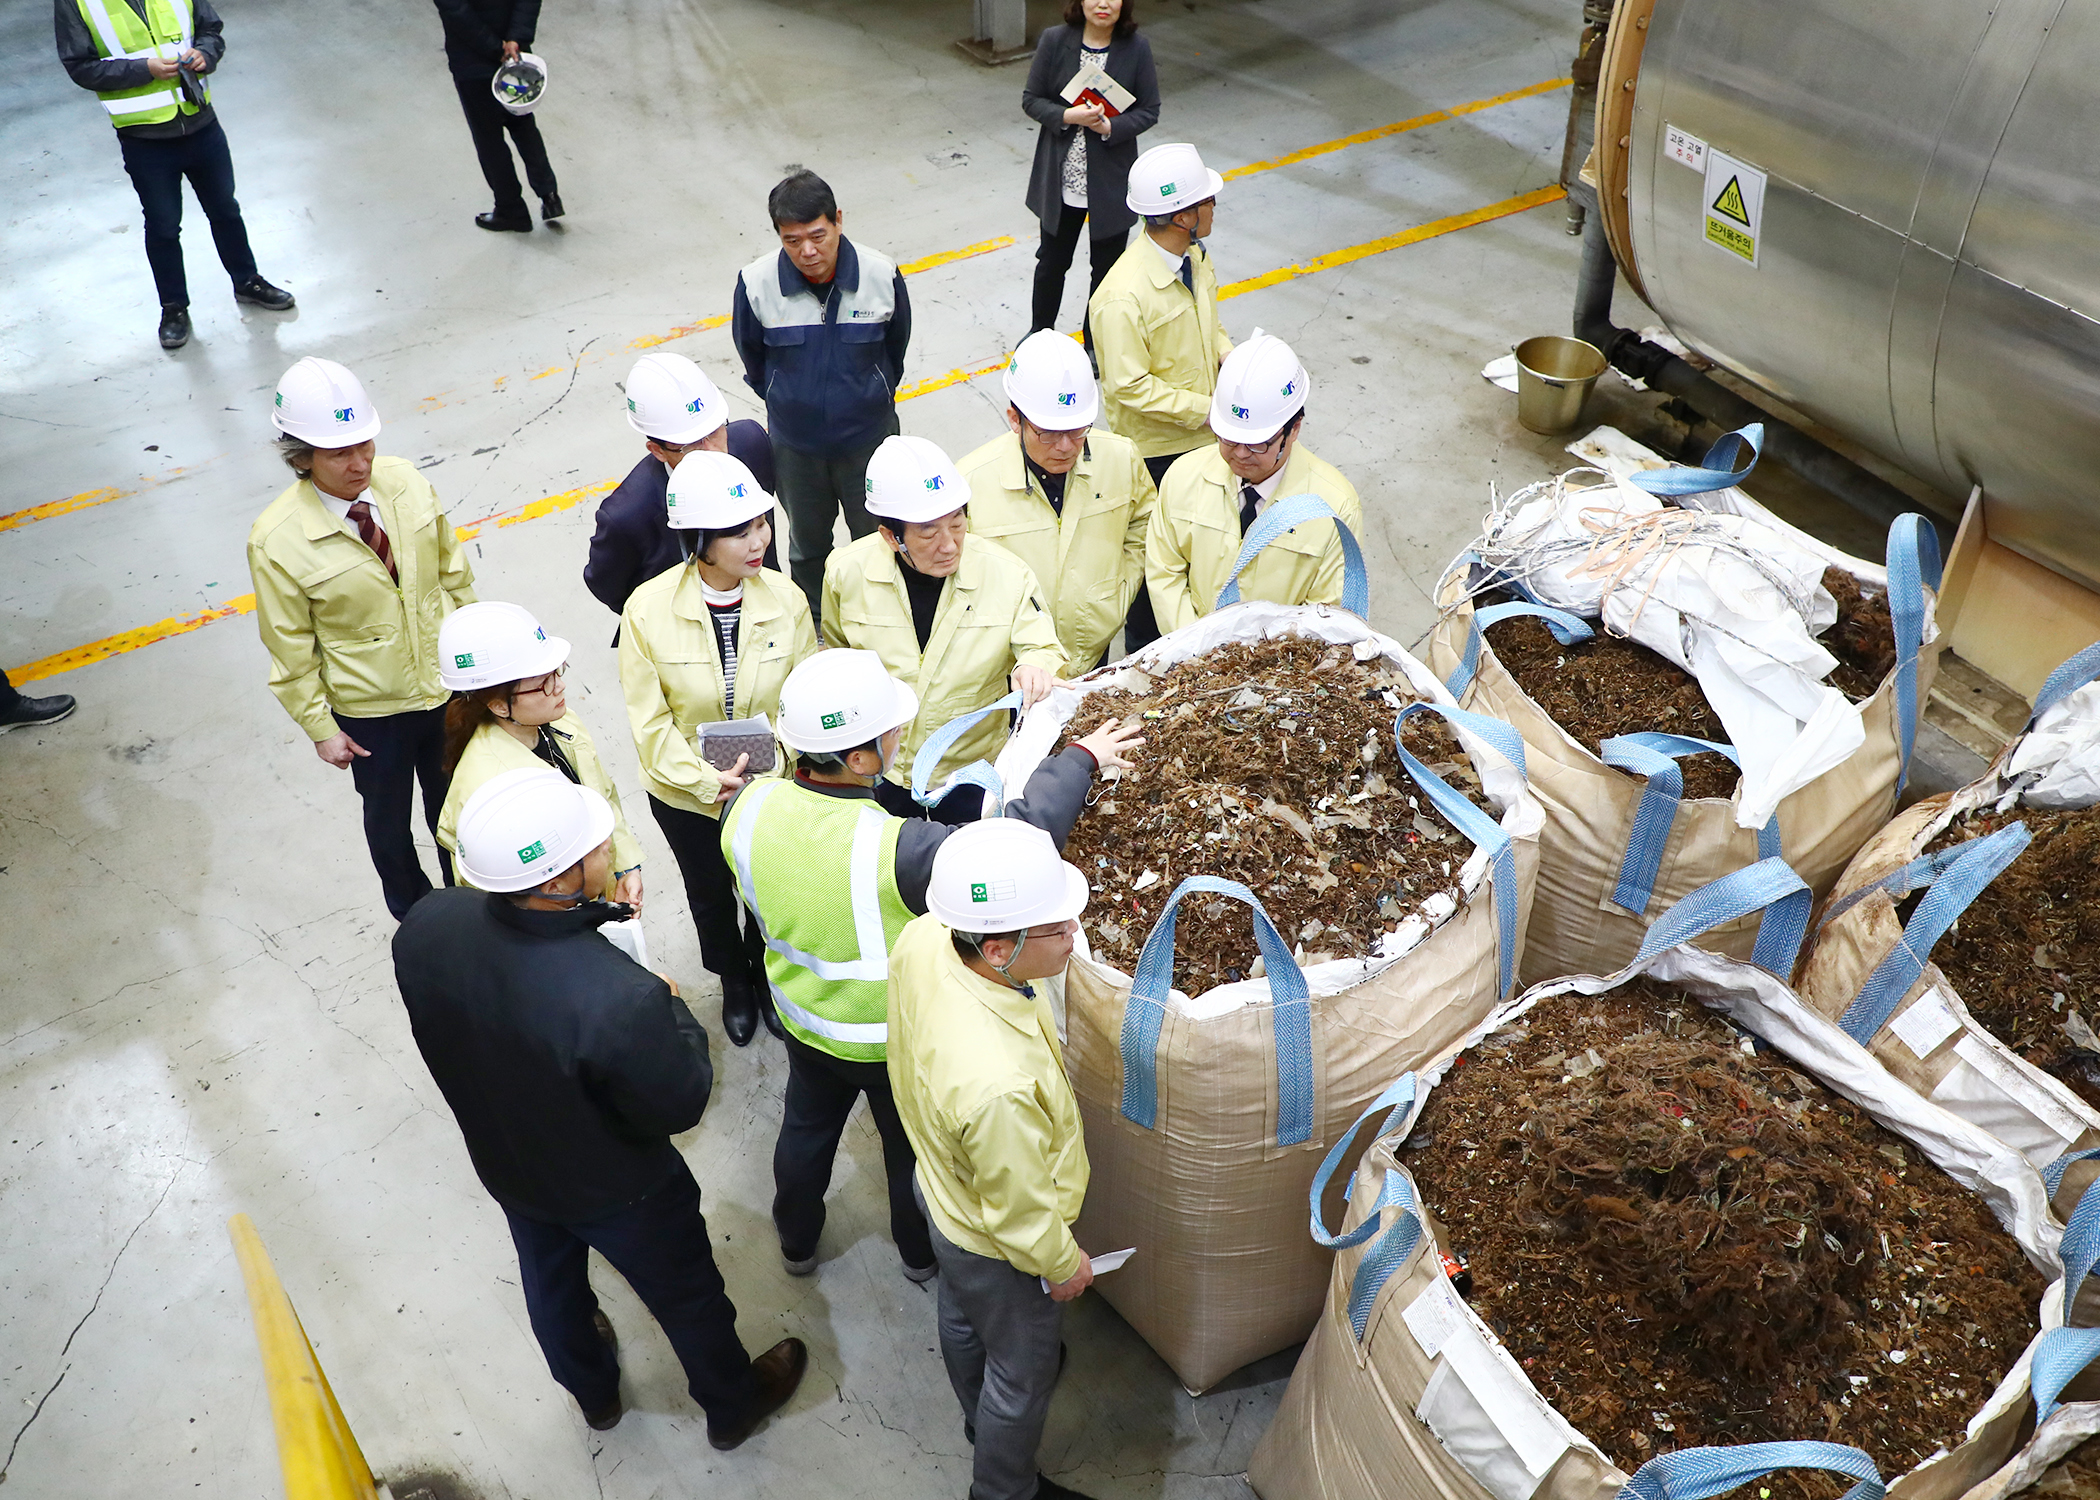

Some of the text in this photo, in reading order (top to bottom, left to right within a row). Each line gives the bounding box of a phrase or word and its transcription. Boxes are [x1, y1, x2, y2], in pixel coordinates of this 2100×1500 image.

[1670, 133, 1702, 156] 고온 고열
[1710, 221, 1751, 250] 뜨거움주의
